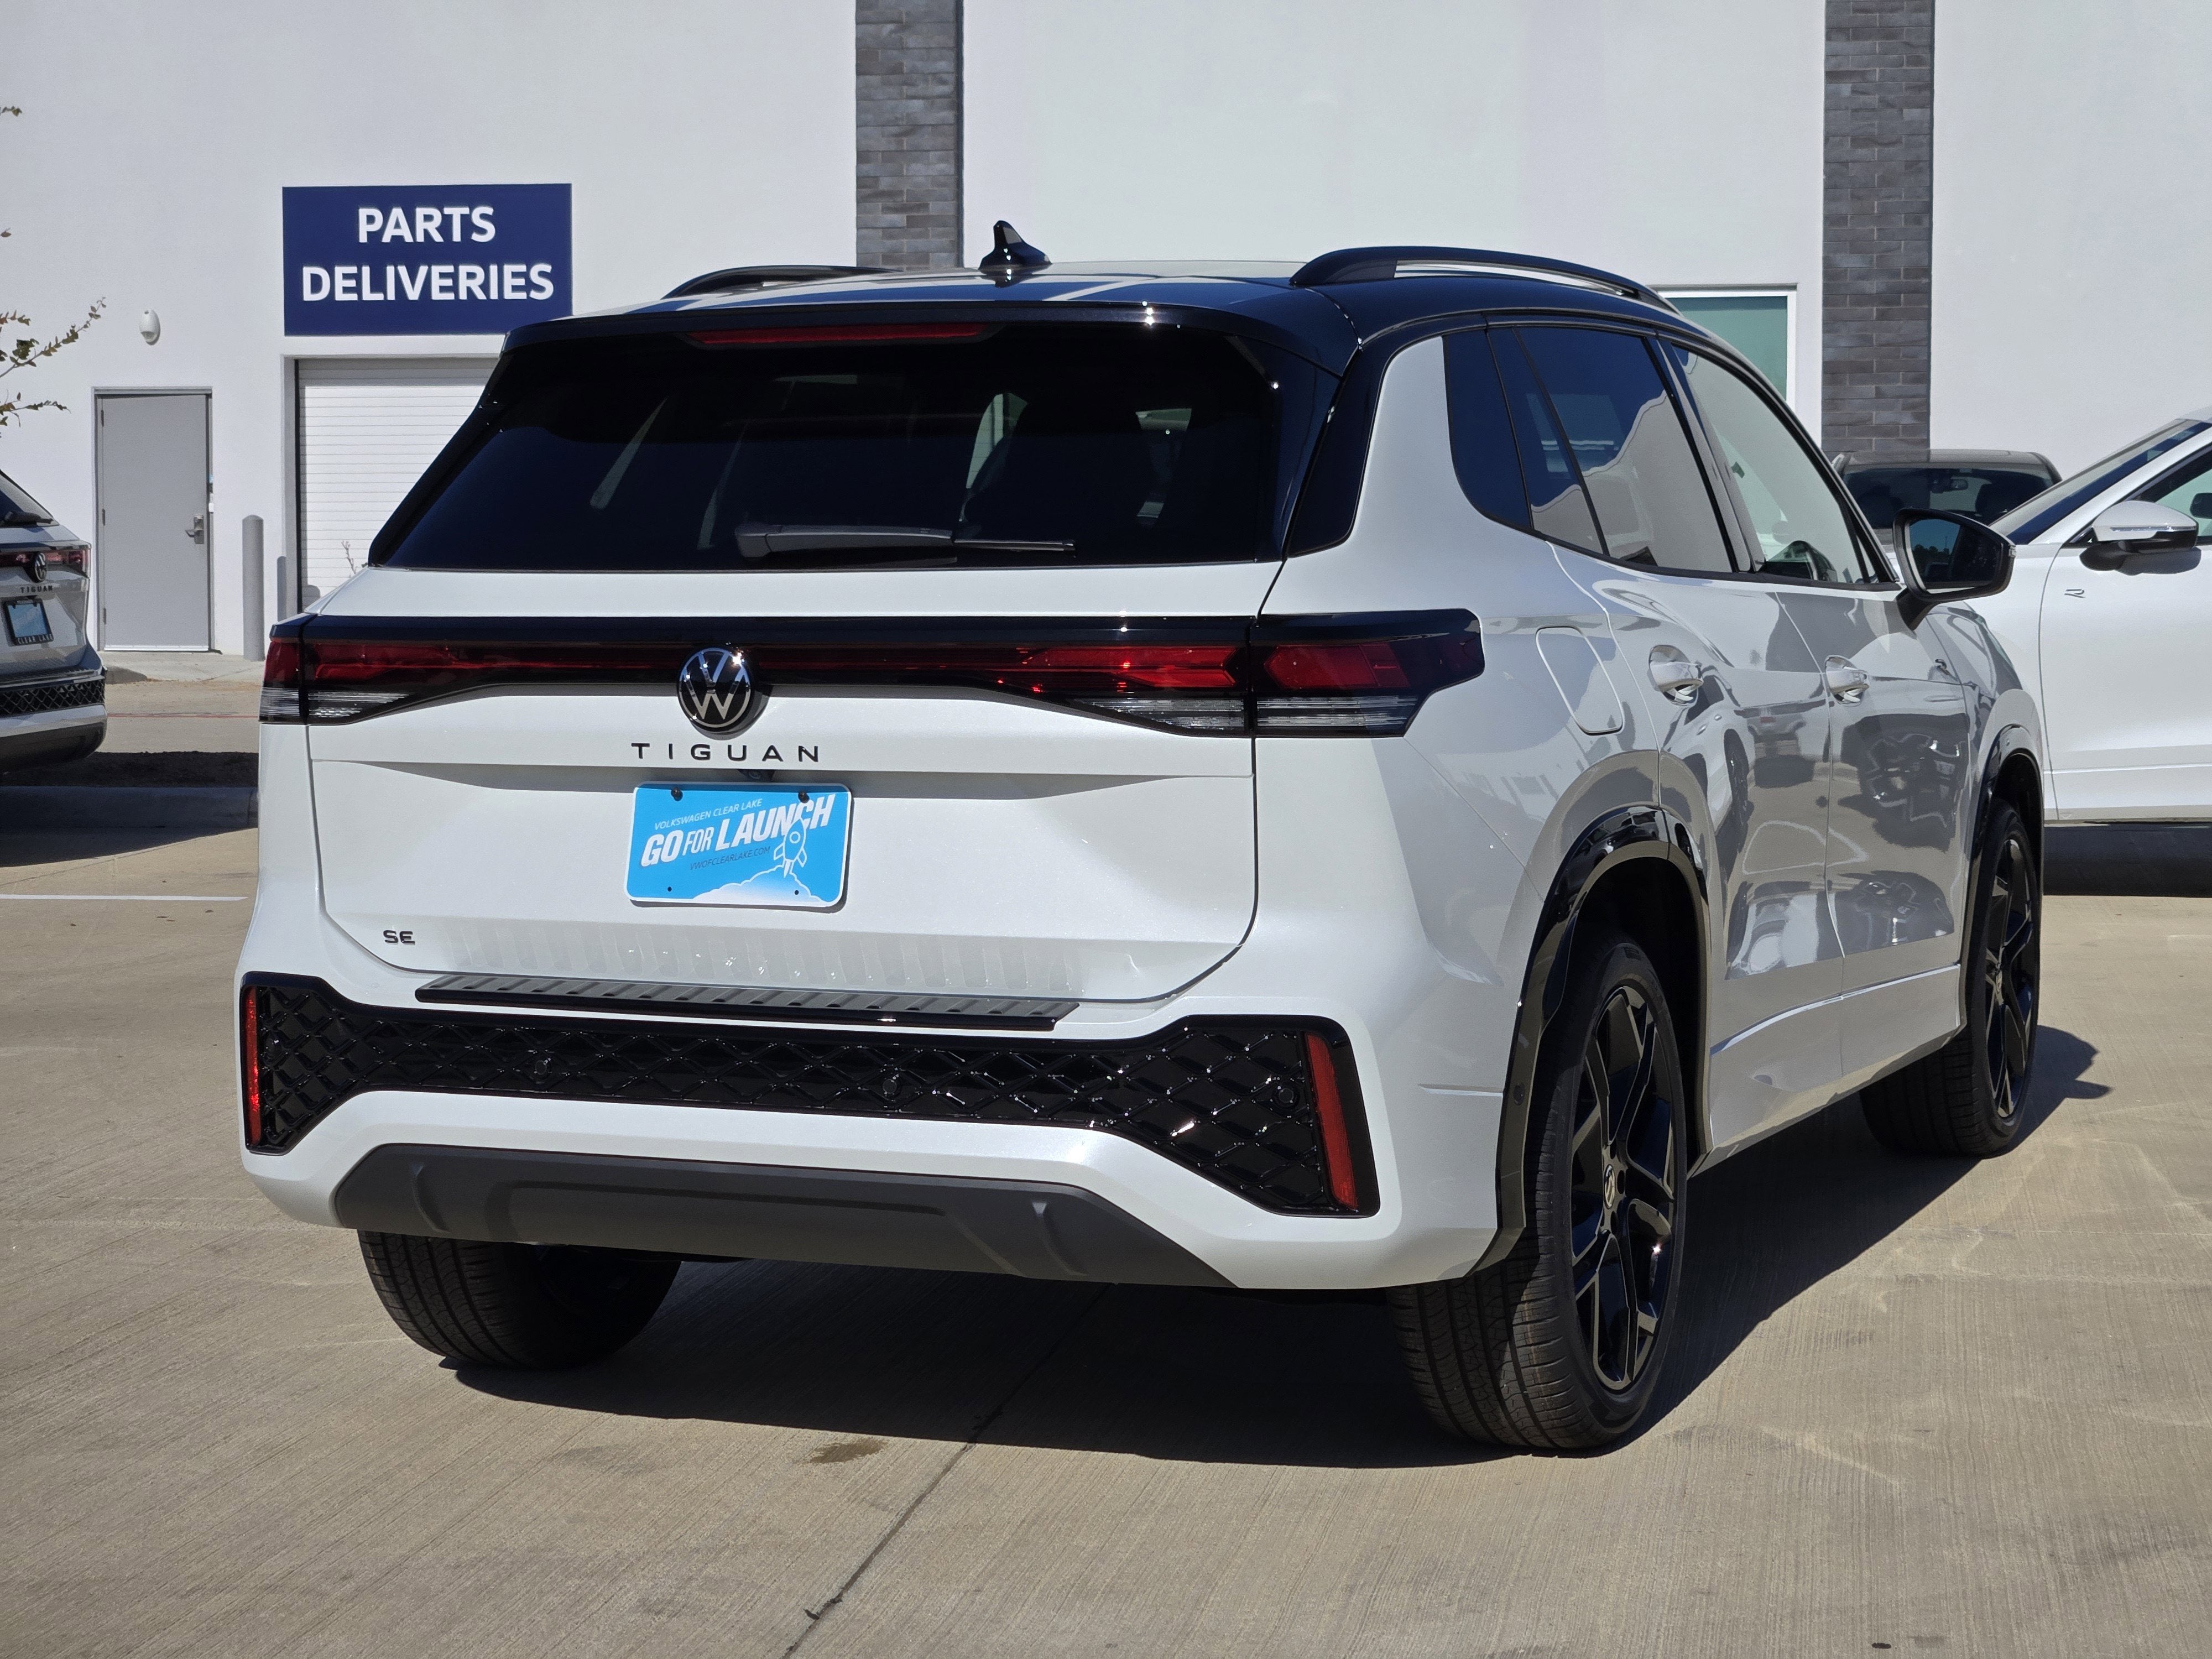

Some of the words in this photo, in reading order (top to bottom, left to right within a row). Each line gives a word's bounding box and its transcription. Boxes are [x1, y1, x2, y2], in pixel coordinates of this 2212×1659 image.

[358, 206, 495, 243] PARTS
[302, 263, 554, 301] DELIVERIES
[20, 585, 53, 593] TIGUAN
[679, 648, 750, 728] VW
[632, 743, 819, 763] TIGUAN
[655, 810, 712, 830] VOLKSWAGEN
[713, 804, 740, 817] CLEAR
[741, 799, 763, 811] LAKE
[641, 830, 684, 867] GO
[682, 826, 715, 856] FOR
[715, 794, 836, 851] LAUNCH
[690, 846, 770, 870] VWOFCLEARLAKE.COM
[383, 930, 415, 945] SE
